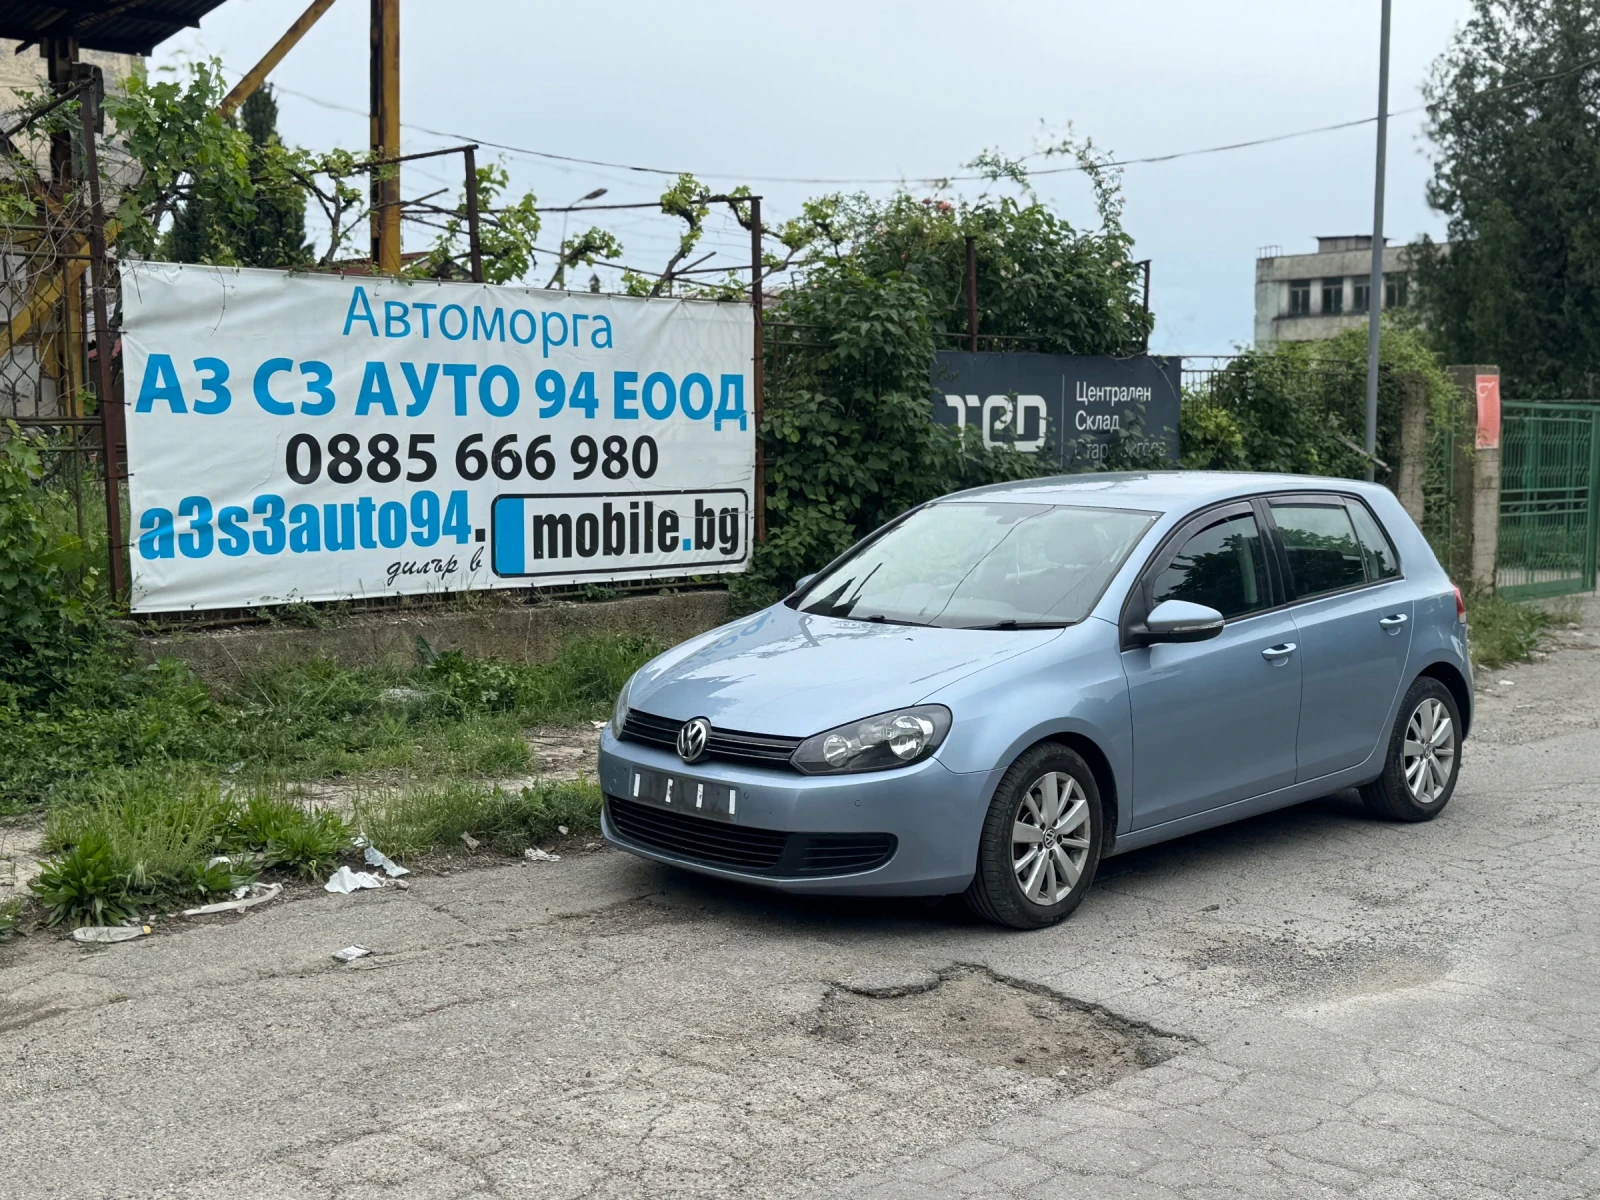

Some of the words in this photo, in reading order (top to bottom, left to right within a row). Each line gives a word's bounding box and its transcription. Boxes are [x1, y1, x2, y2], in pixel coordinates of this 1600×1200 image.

[342, 285, 615, 359] Автоморга
[354, 360, 522, 419] АУТО
[534, 368, 600, 420] 94
[613, 370, 749, 433] ЕООД
[1075, 381, 1152, 406] Централен
[1075, 410, 1120, 433] Склад
[285, 433, 437, 484] 0885
[455, 433, 556, 482] 666
[570, 434, 659, 481] 980
[533, 498, 740, 560] mobile.bg
[386, 554, 460, 587] дилър
[469, 545, 485, 573] в
